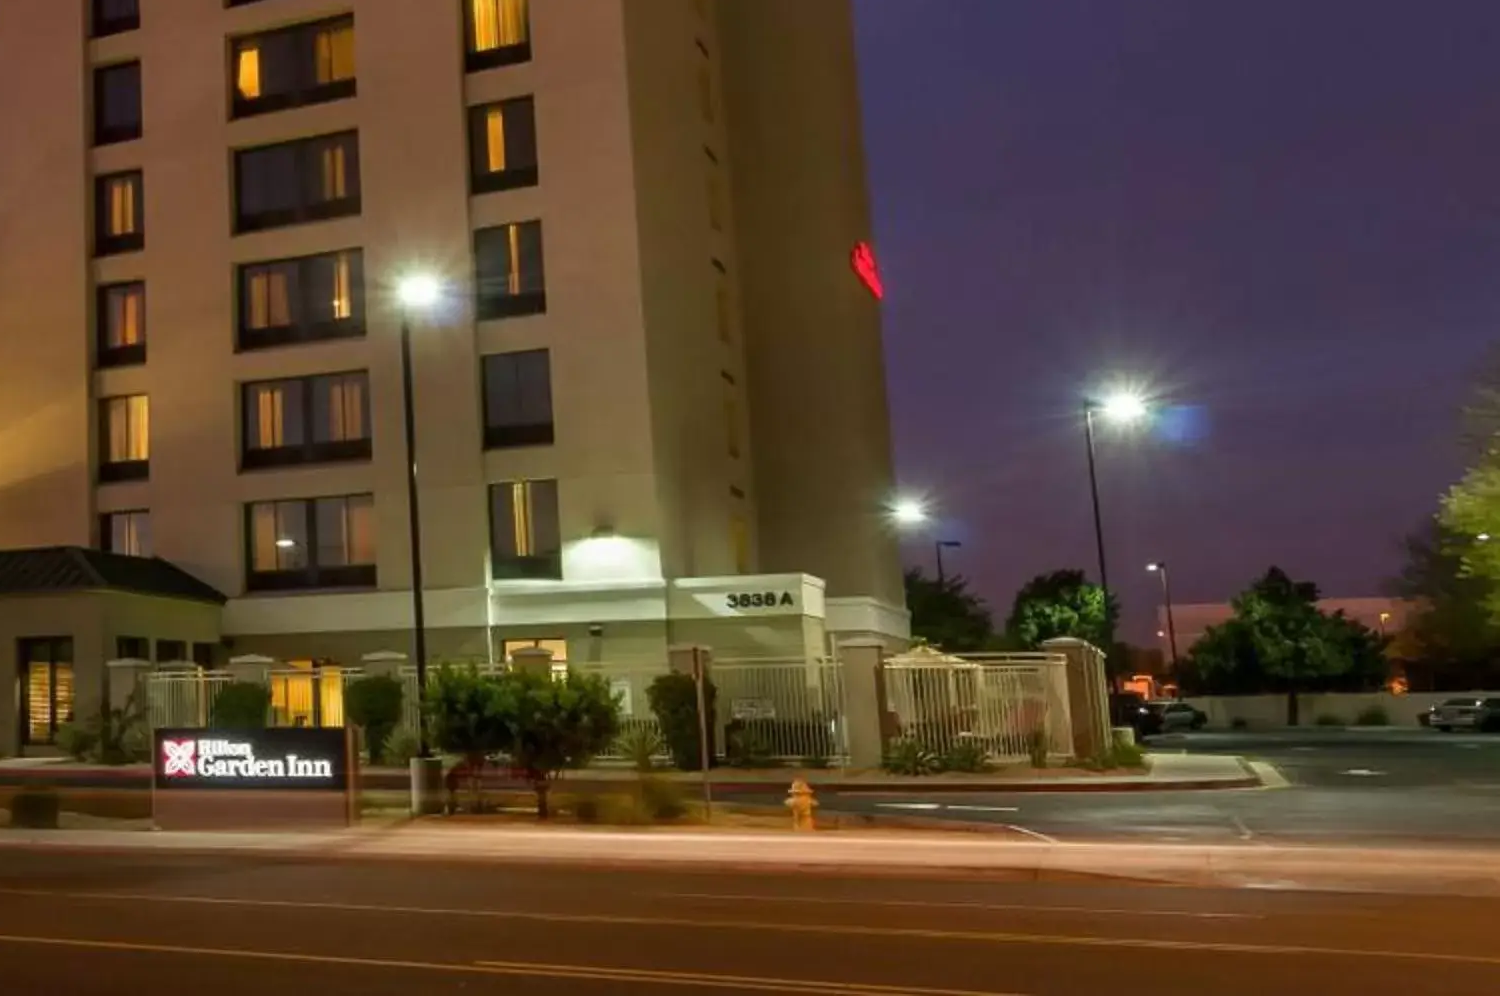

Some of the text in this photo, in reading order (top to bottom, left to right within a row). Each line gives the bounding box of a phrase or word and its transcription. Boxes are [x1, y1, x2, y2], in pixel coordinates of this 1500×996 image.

[726, 590, 794, 608] 3838 A
[197, 739, 252, 756] Hilton
[197, 754, 333, 777] Garden Inn
